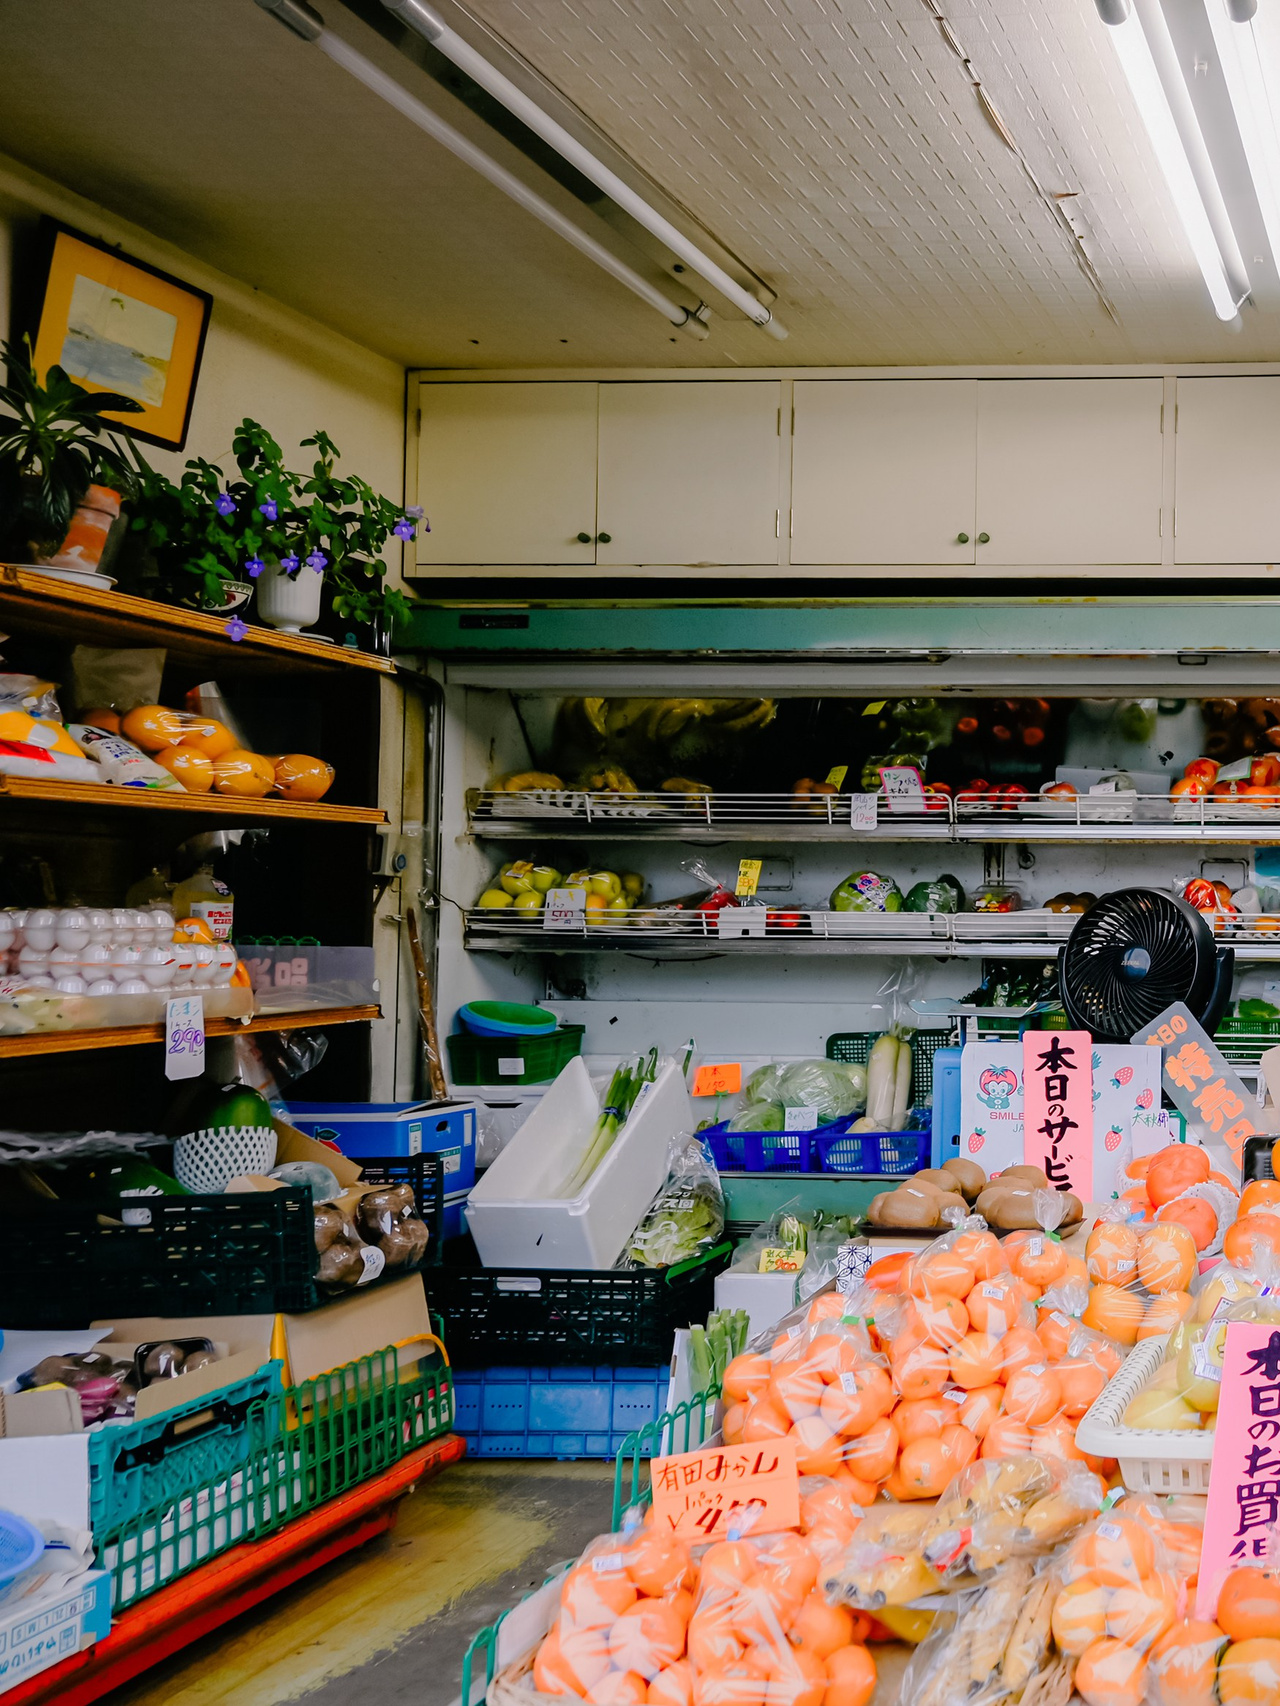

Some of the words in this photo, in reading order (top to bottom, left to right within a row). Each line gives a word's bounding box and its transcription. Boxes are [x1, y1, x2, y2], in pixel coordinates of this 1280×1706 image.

[168, 1028, 206, 1055] 290
[989, 1111, 1024, 1121] SMILE
[1035, 1036, 1079, 1192] 本日のサービ
[656, 1451, 779, 1493] 有田みかん
